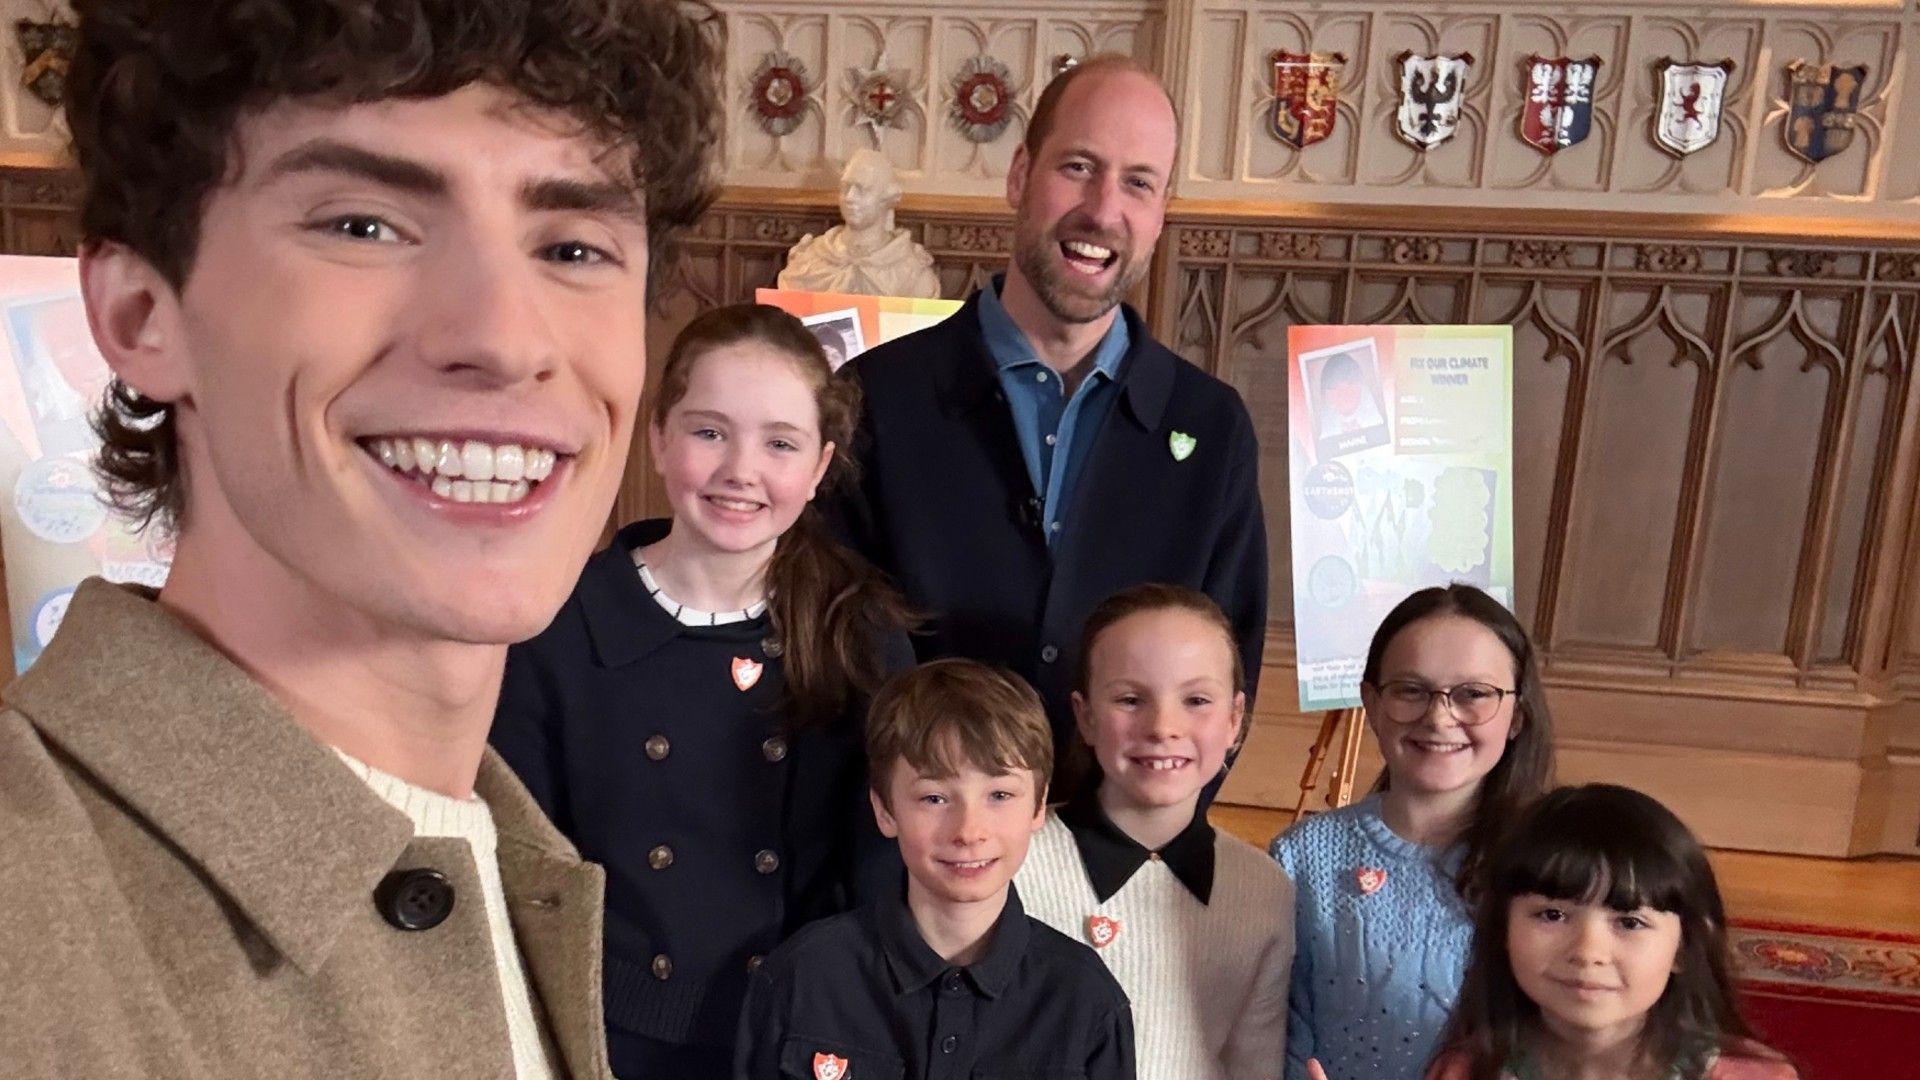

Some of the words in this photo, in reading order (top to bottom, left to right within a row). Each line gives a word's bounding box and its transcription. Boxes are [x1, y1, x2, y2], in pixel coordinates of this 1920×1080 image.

[1410, 357, 1426, 369] FIX
[1427, 357, 1448, 369] OUR
[1449, 356, 1489, 370] CLIMATE
[1430, 374, 1468, 385] WINNER
